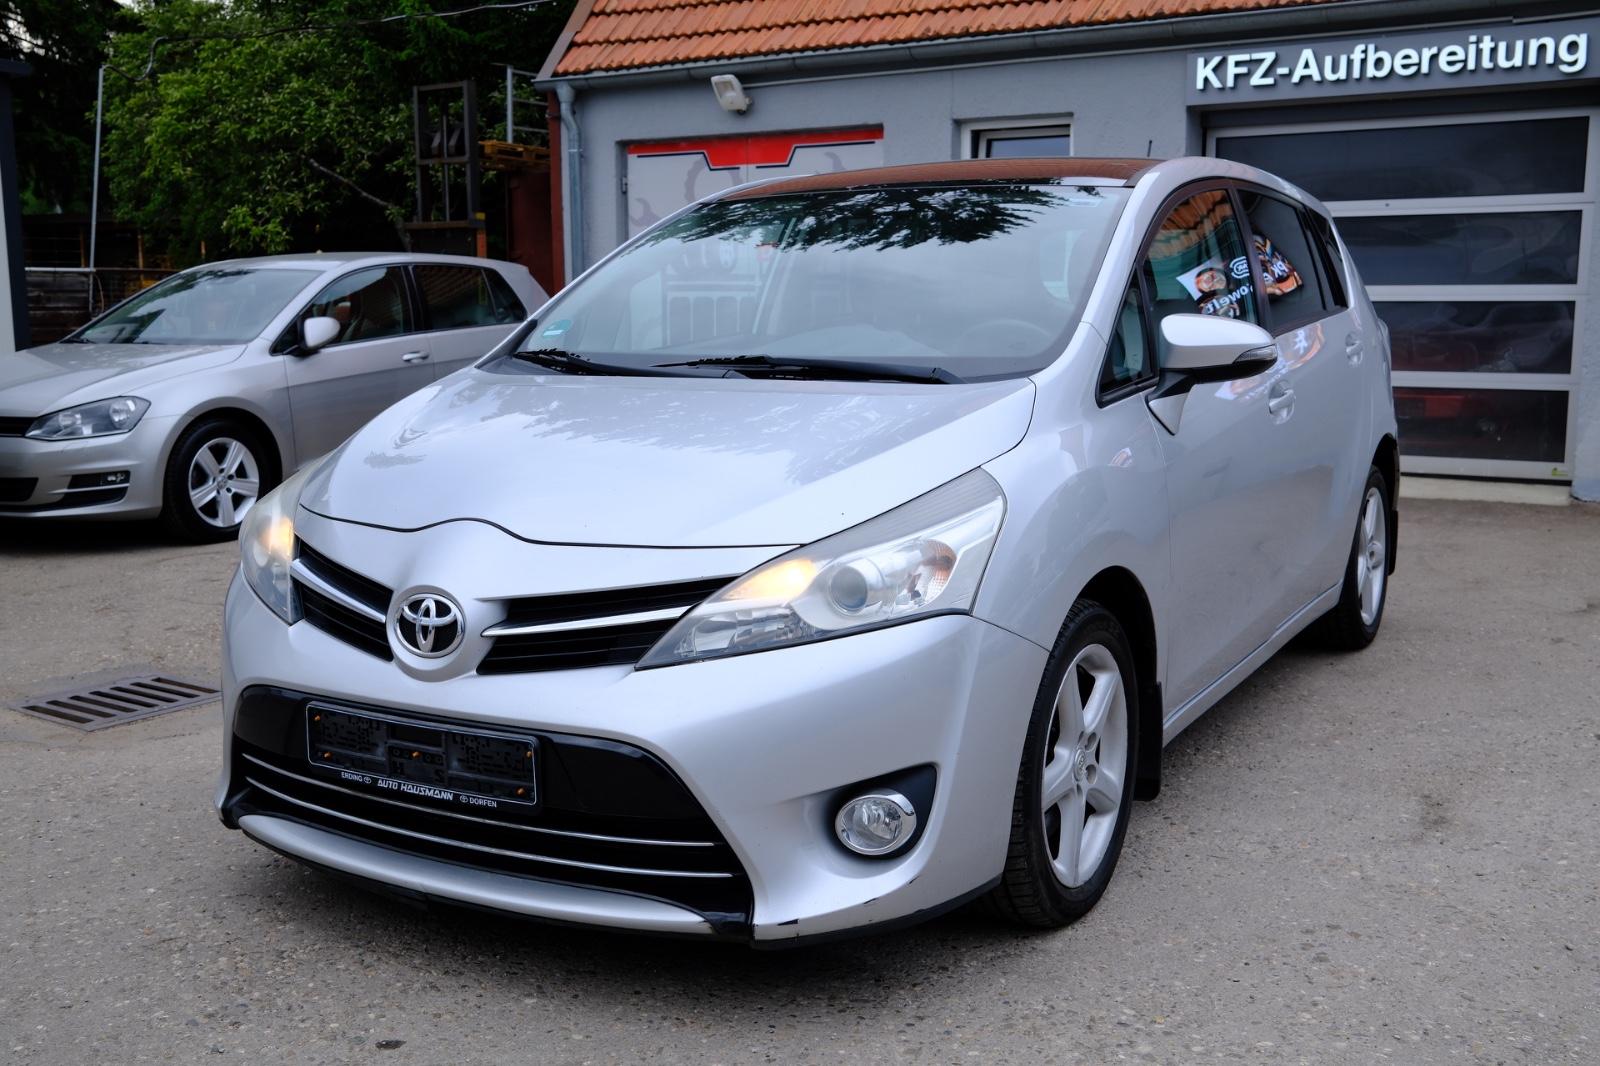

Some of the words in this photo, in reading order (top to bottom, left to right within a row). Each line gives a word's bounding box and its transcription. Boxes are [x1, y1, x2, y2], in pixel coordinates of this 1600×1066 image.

[1195, 32, 1589, 90] KFZ-Aufbereitung
[341, 771, 363, 782] ERDING
[377, 779, 399, 790] AUTO
[400, 783, 454, 801] HAUSMANN
[469, 797, 497, 808] DORFEN
